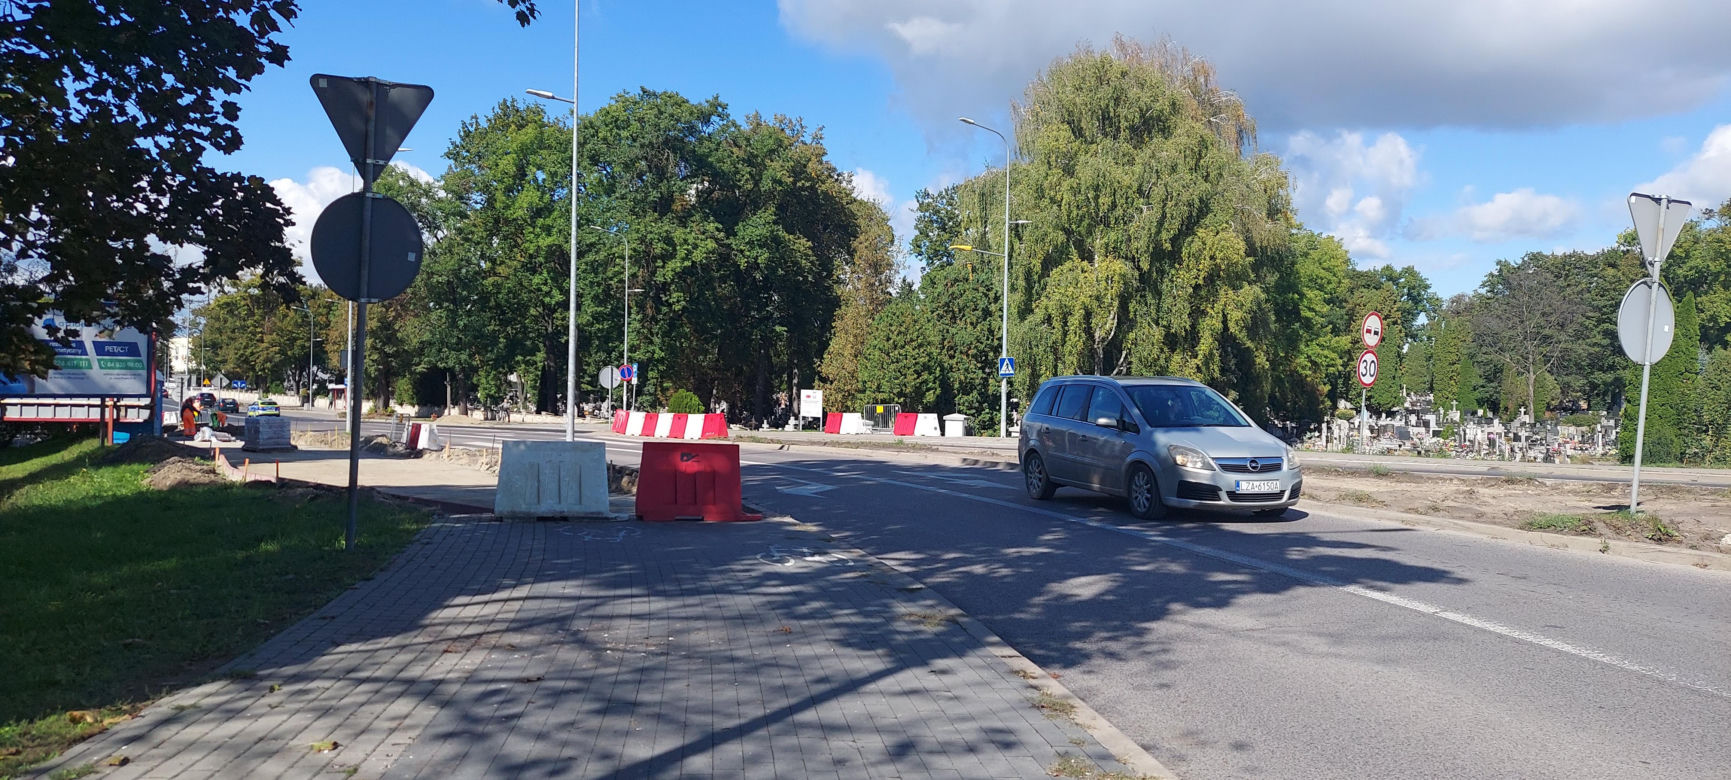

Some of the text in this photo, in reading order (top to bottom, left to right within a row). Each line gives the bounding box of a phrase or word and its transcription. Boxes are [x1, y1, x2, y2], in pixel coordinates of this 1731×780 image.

[105, 345, 129, 353] PET/CT
[1361, 360, 1376, 377] 30
[1240, 481, 1255, 491] LZA
